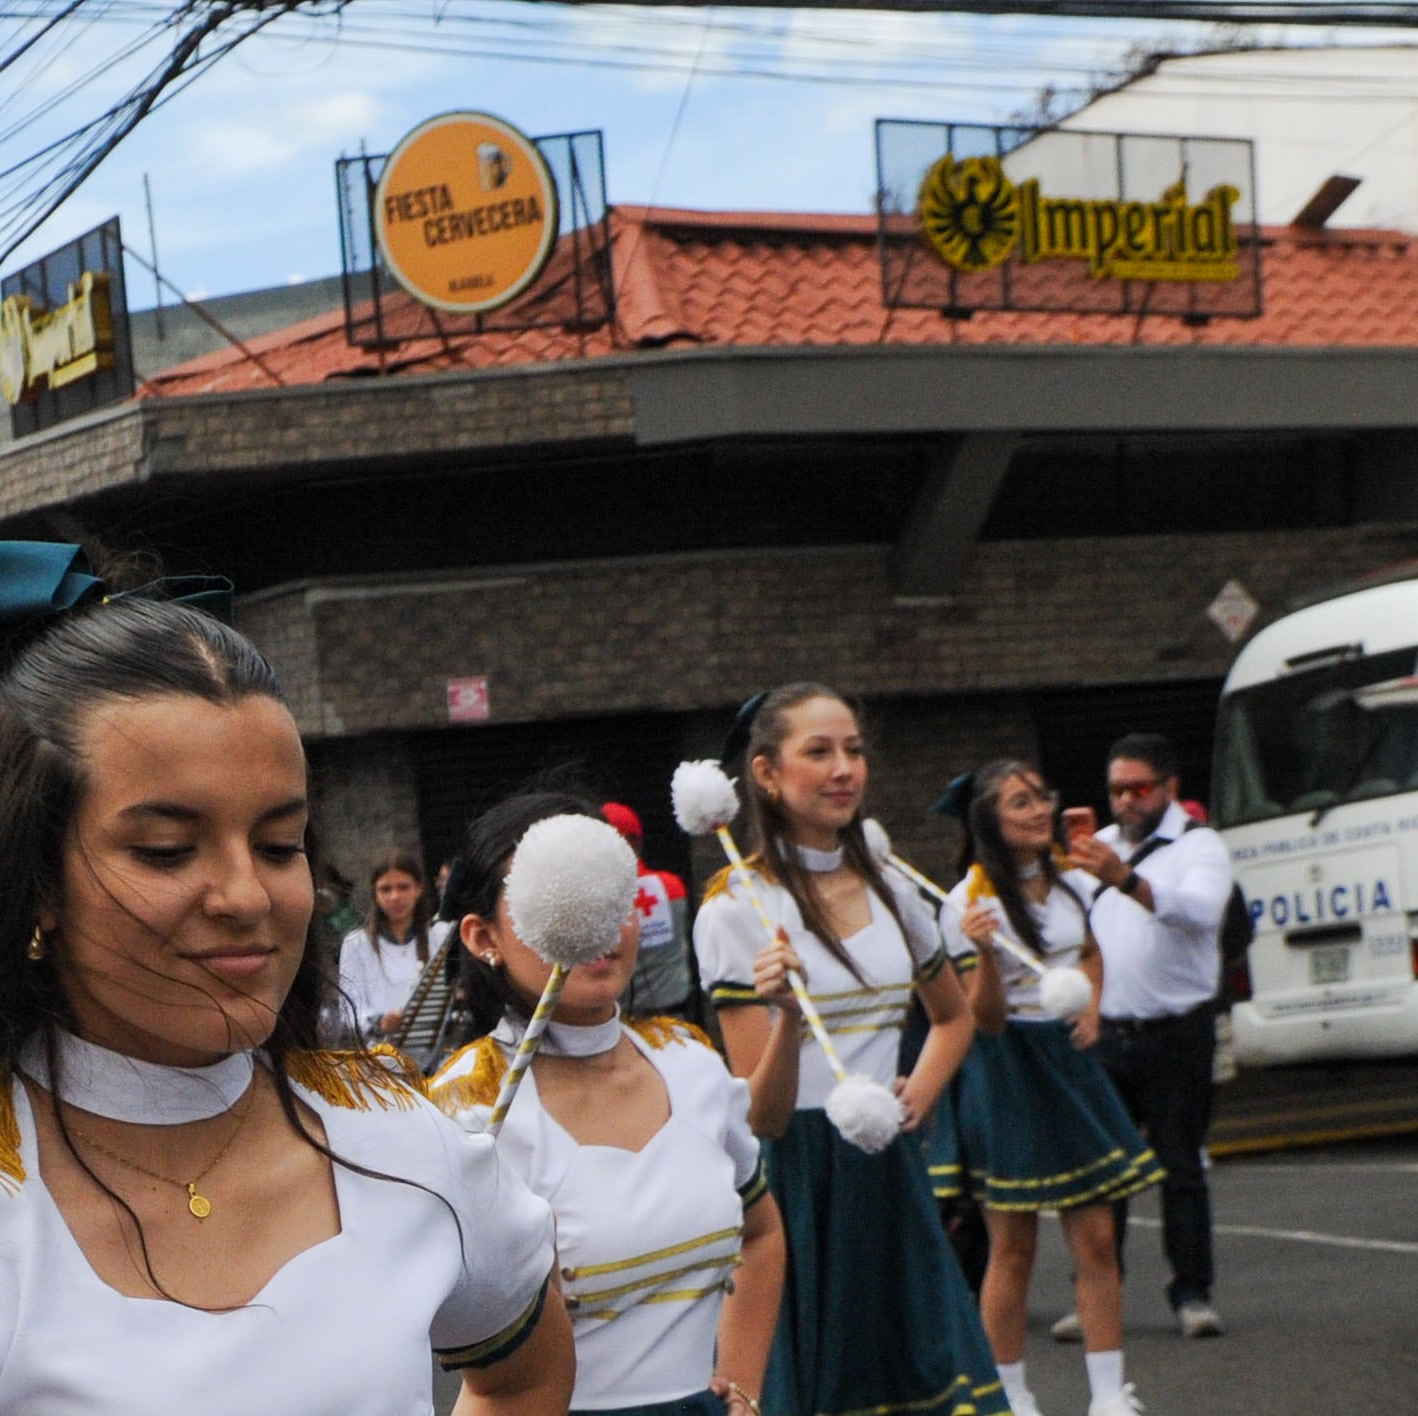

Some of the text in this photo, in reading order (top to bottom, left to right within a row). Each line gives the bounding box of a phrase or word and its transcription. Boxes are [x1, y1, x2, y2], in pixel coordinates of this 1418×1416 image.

[384, 184, 452, 225] FIESTA
[424, 195, 543, 247] CERVECERA
[1024, 180, 1239, 282] Imperial
[1247, 879, 1392, 933] POLICIA
